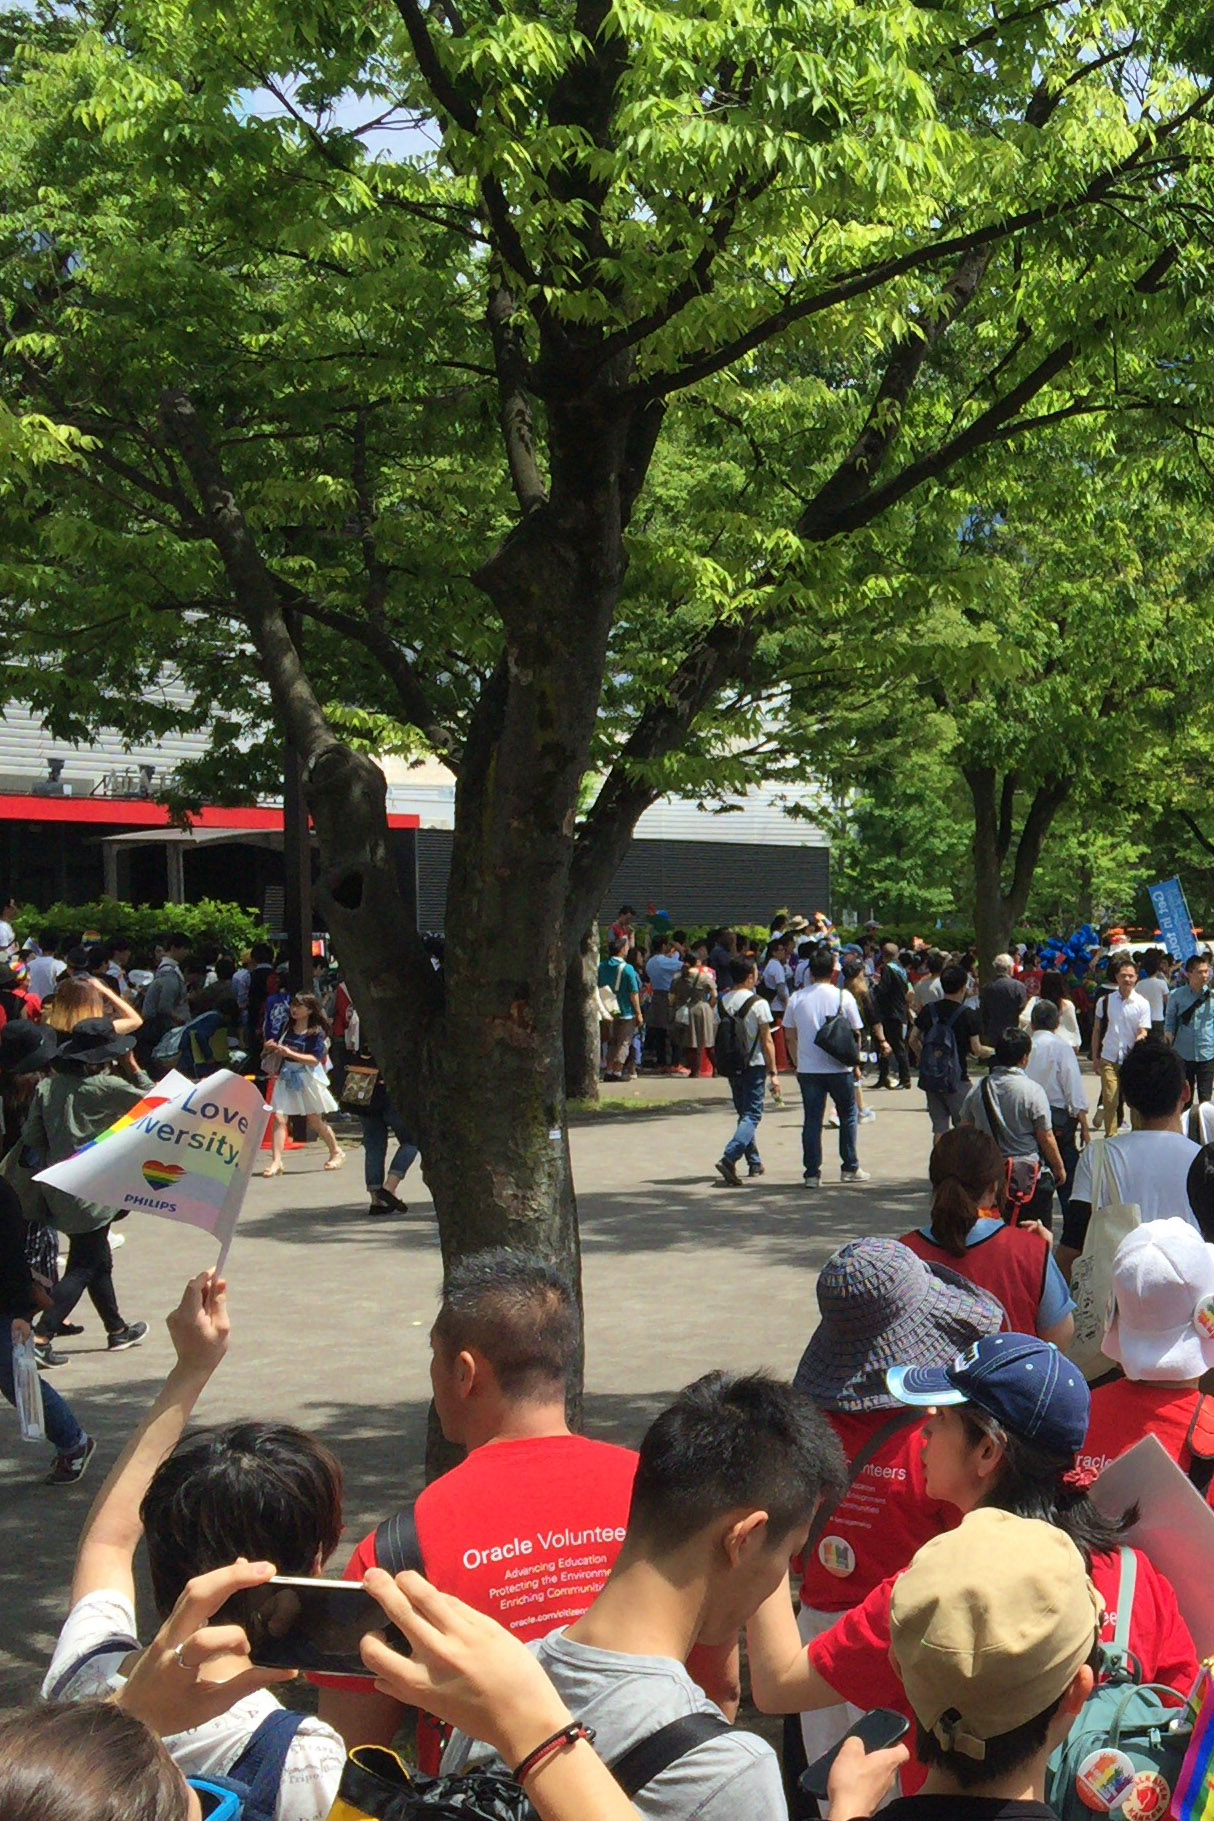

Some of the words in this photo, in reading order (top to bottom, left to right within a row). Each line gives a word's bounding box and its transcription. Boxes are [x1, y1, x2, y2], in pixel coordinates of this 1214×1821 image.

[180, 1088, 249, 1134] Love
[130, 1116, 239, 1168] iversity.
[124, 1193, 177, 1212] PHILIPS
[862, 1464, 907, 1480] nteers
[1076, 1454, 1113, 1469] racl
[463, 1537, 533, 1569] Oracle
[537, 1527, 626, 1550] Voluntee
[504, 1560, 555, 1580] Advancing
[558, 1554, 607, 1568] Education
[489, 1578, 539, 1598] Protecting
[541, 1574, 558, 1585] the
[561, 1568, 612, 1582] Environme
[500, 1590, 545, 1610] Enriching
[547, 1582, 605, 1599] Communiti
[509, 1606, 589, 1629] oracle.com/citizen
